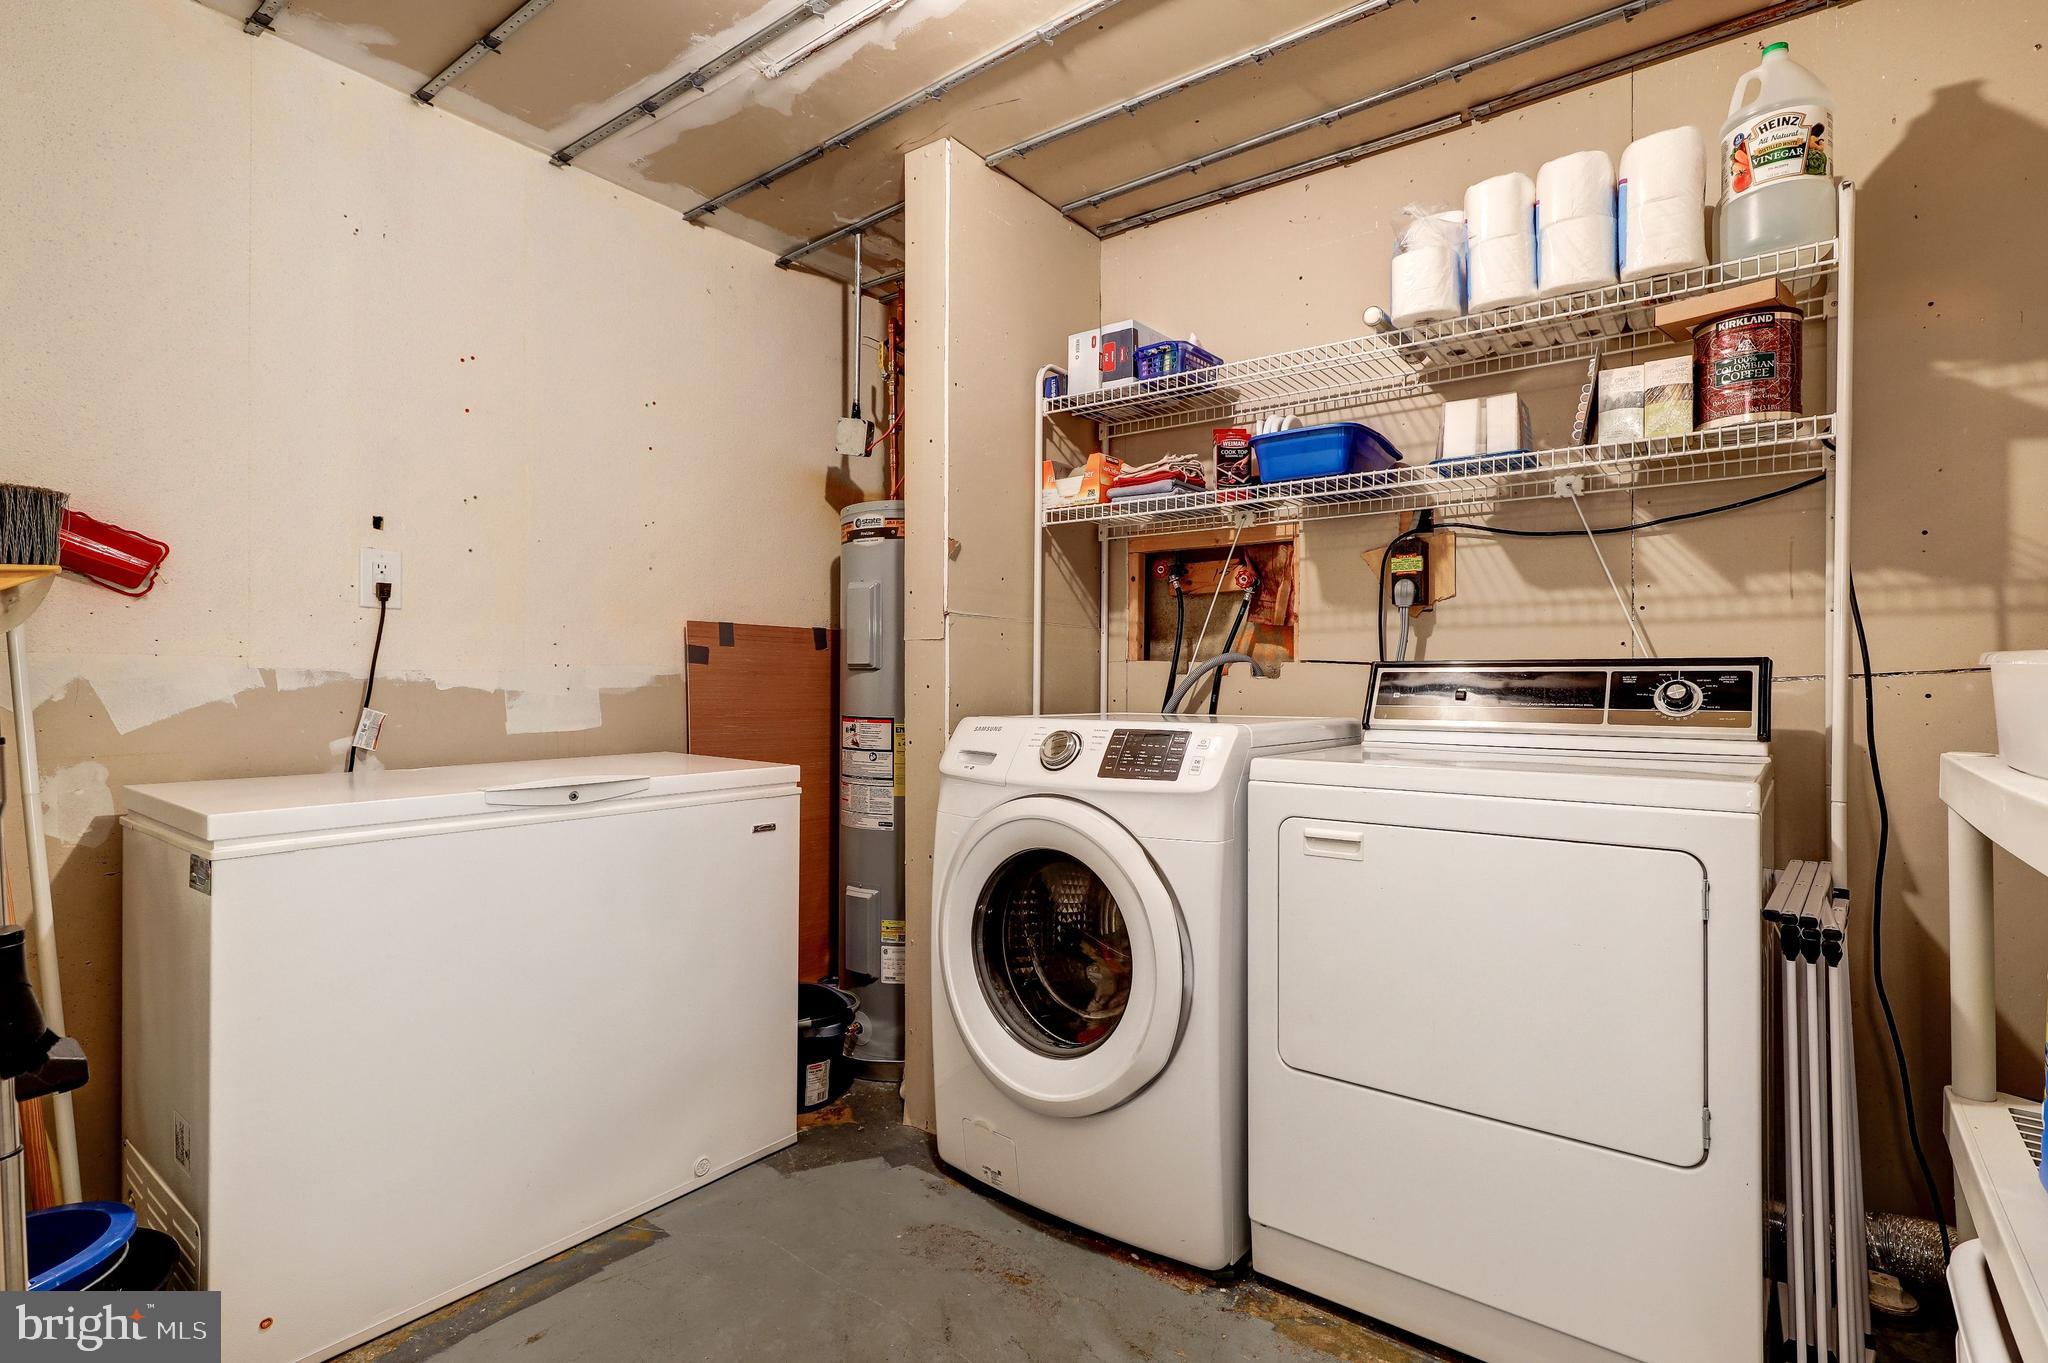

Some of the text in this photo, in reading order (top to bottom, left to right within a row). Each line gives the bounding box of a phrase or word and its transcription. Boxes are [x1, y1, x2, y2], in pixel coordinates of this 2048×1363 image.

[1757, 116, 1800, 134] HEINZ
[1758, 130, 1799, 146] All Natural
[1758, 142, 1783, 154] DISTILLED
[1752, 147, 1804, 166] VINEGAR
[1718, 314, 1773, 331] KIRKLAND
[1733, 354, 1758, 365] 100%
[1716, 360, 1775, 376] COLOMBIAN
[1721, 367, 1770, 383] COFFEE
[861, 517, 882, 525] state
